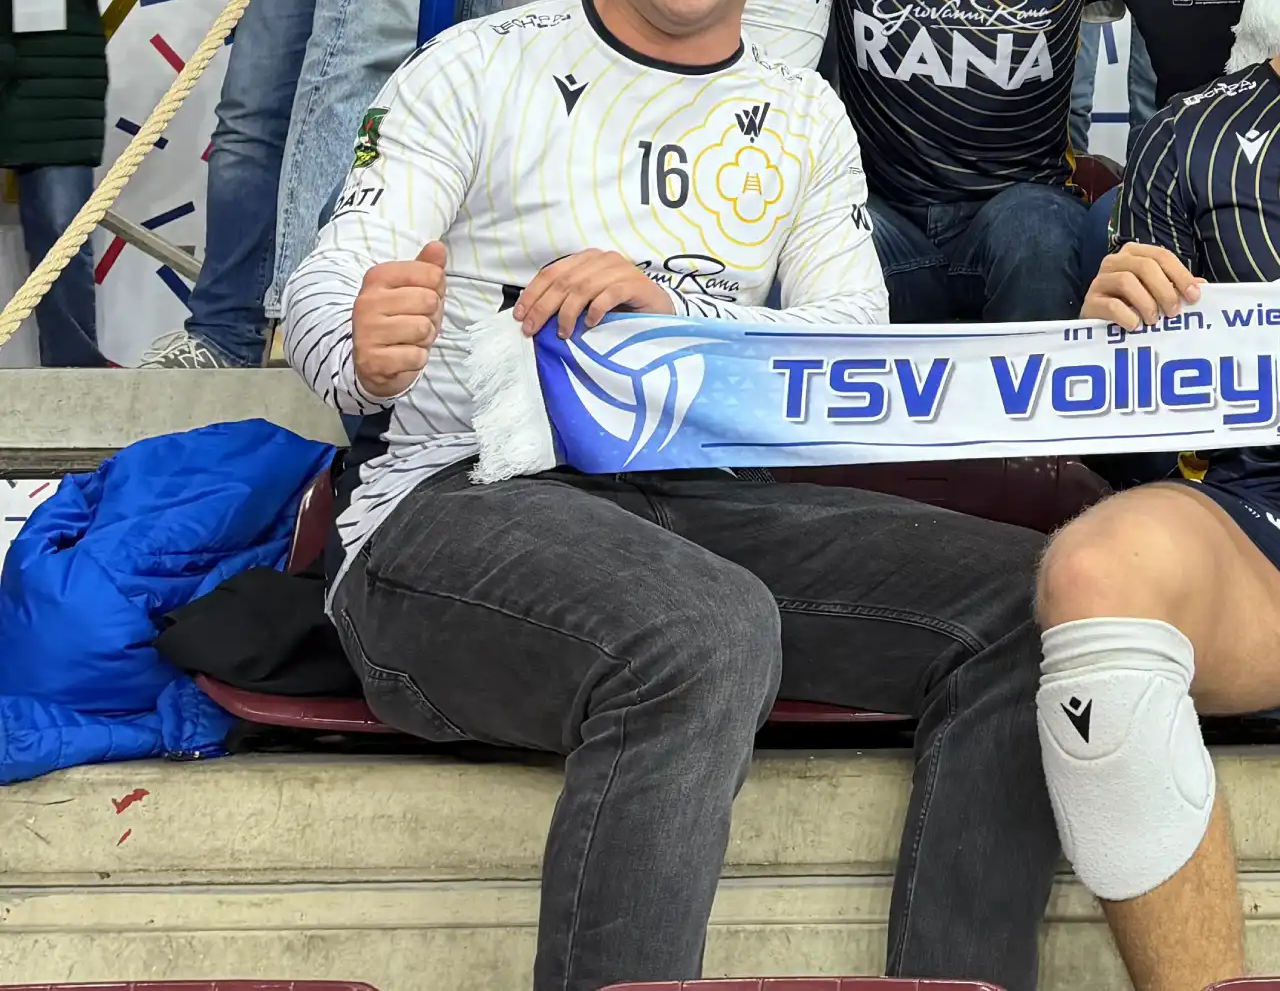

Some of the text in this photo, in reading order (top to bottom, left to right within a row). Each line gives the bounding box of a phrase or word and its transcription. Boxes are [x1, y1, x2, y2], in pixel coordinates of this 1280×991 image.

[853, 8, 1054, 90] RANA
[638, 140, 690, 209] 16
[772, 358, 950, 419] TSV
